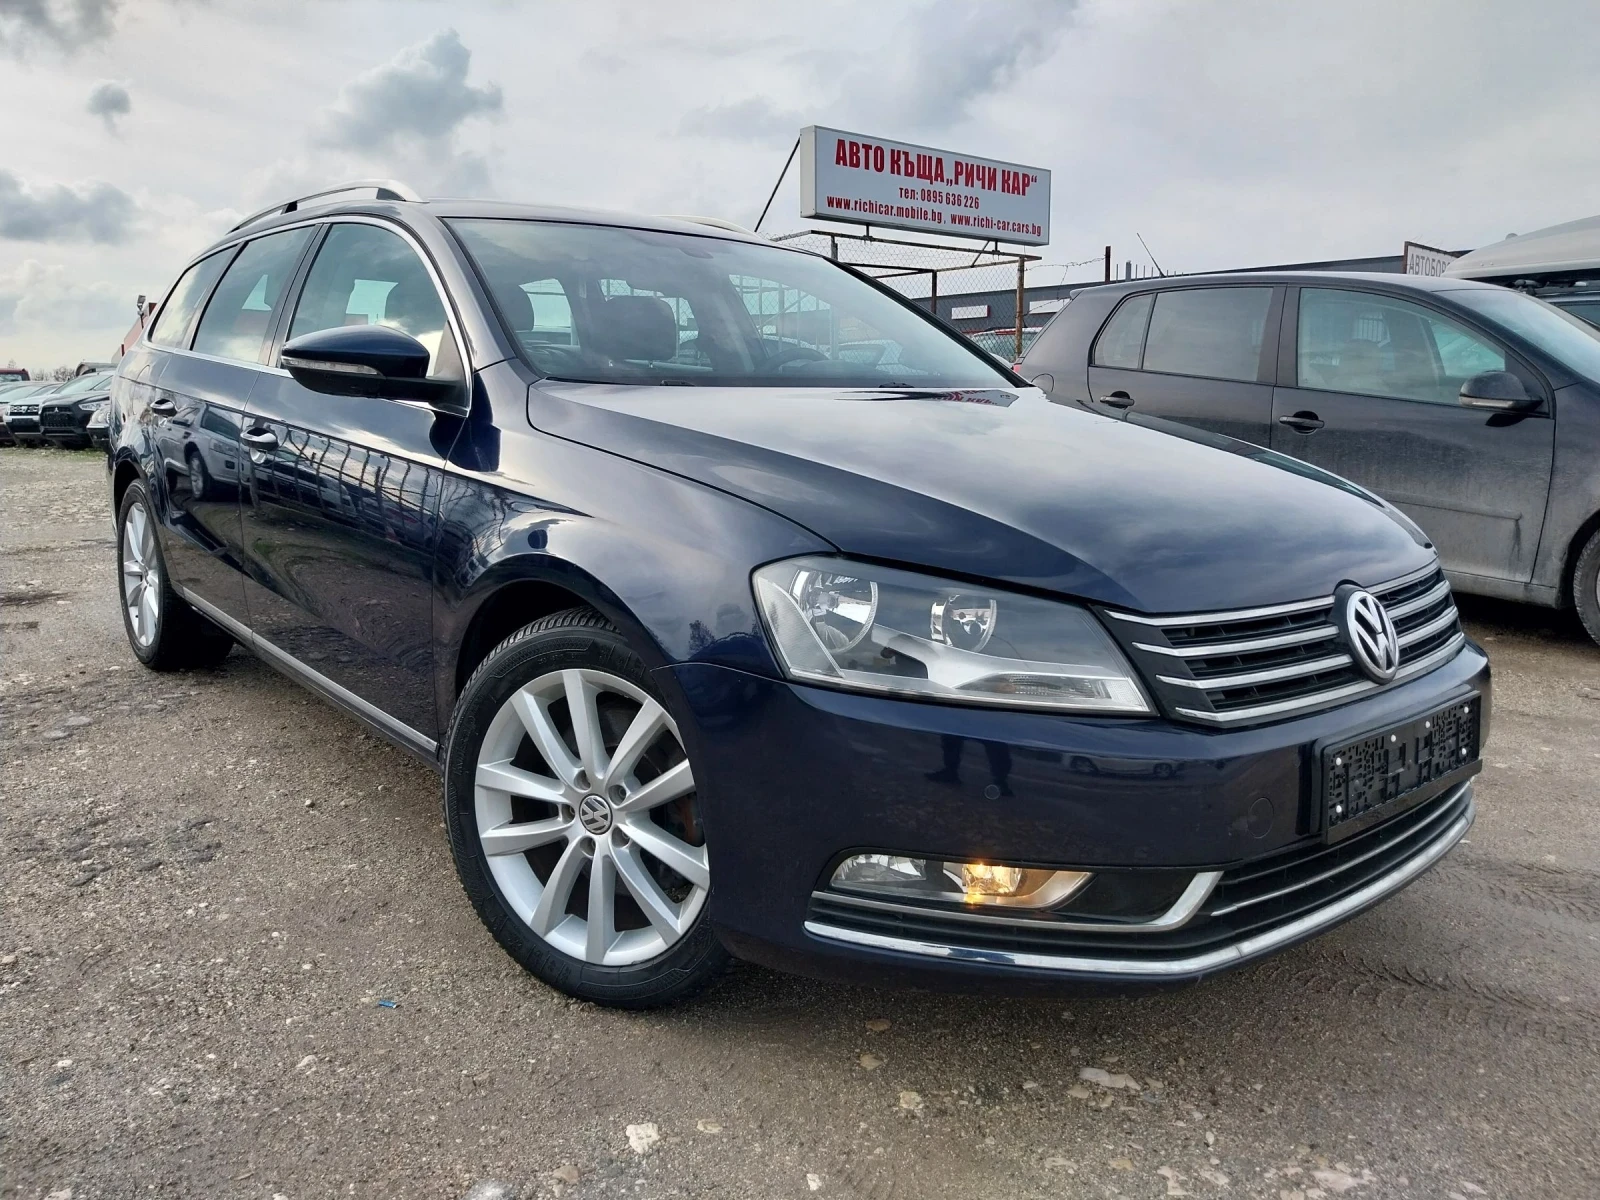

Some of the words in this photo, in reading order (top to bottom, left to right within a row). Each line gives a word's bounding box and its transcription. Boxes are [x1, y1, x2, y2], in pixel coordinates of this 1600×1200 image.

[835, 138, 885, 173] АВТО
[889, 148, 945, 185] КЪЩА
[899, 187, 919, 201] тел:
[920, 188, 944, 205] 0895
[945, 192, 962, 207] 636
[963, 195, 980, 210] 226
[950, 212, 1042, 237] www.richi-car.cars.bg
[1408, 253, 1451, 277] АВТОБОР
